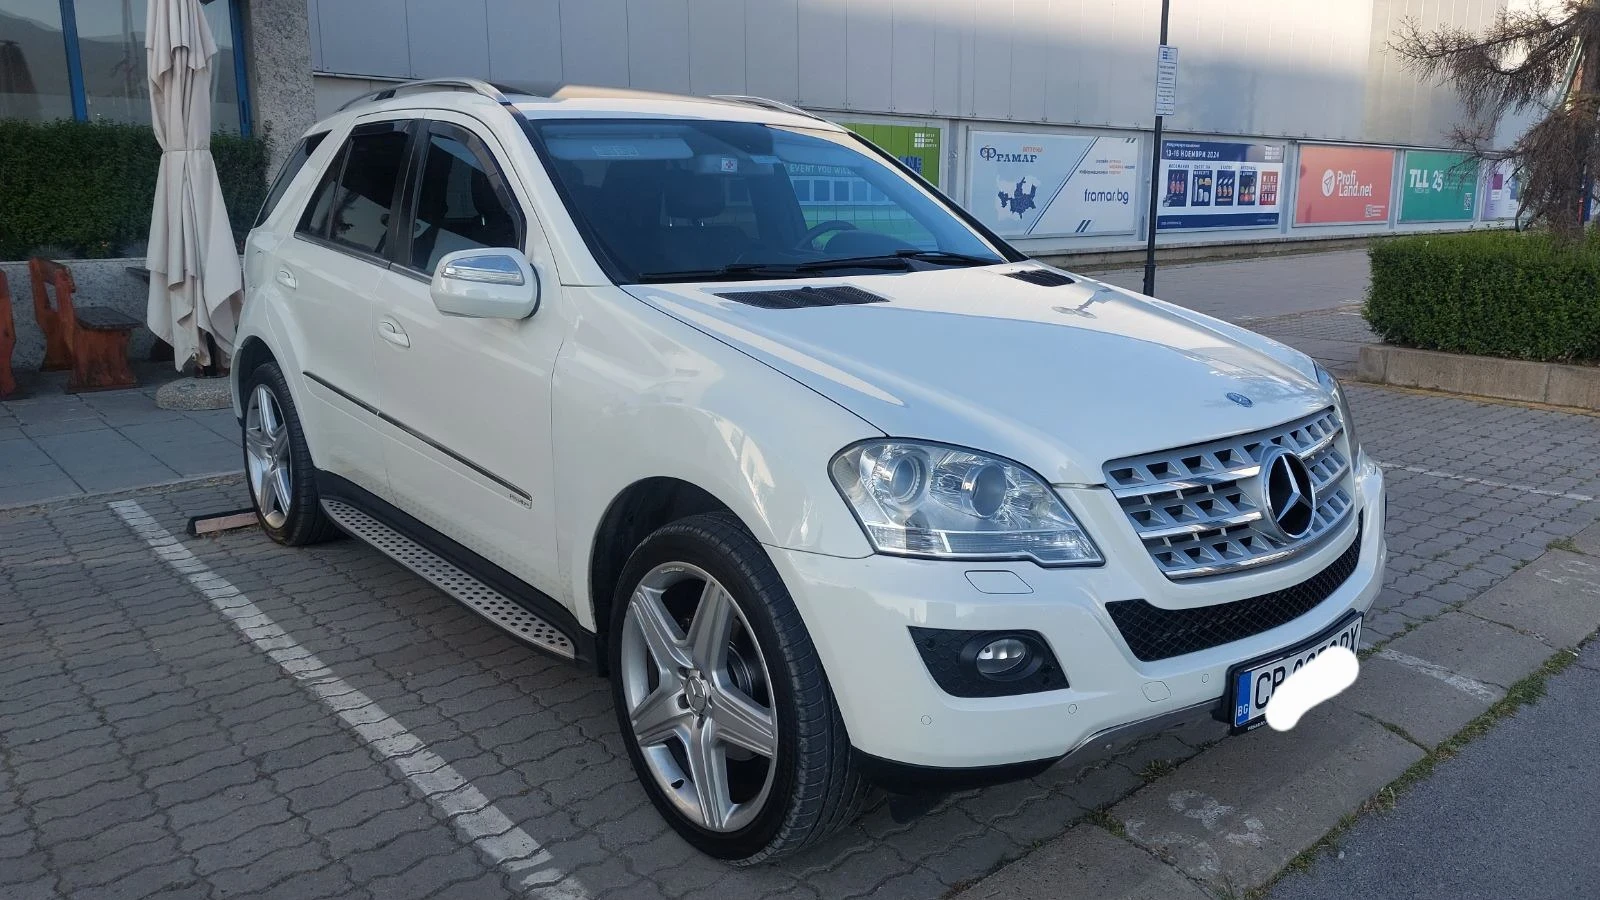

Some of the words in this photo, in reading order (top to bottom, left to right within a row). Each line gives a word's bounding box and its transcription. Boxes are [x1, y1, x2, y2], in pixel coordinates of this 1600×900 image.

[1207, 151, 1220, 159] 2024
[789, 164, 815, 173] EVENT
[817, 165, 832, 173] YOU
[1336, 170, 1357, 186] Profi
[1409, 169, 1430, 188] TLL
[1084, 188, 1129, 205] framar.bg
[1338, 181, 1373, 197] Land.net
[1237, 704, 1249, 717] BG
